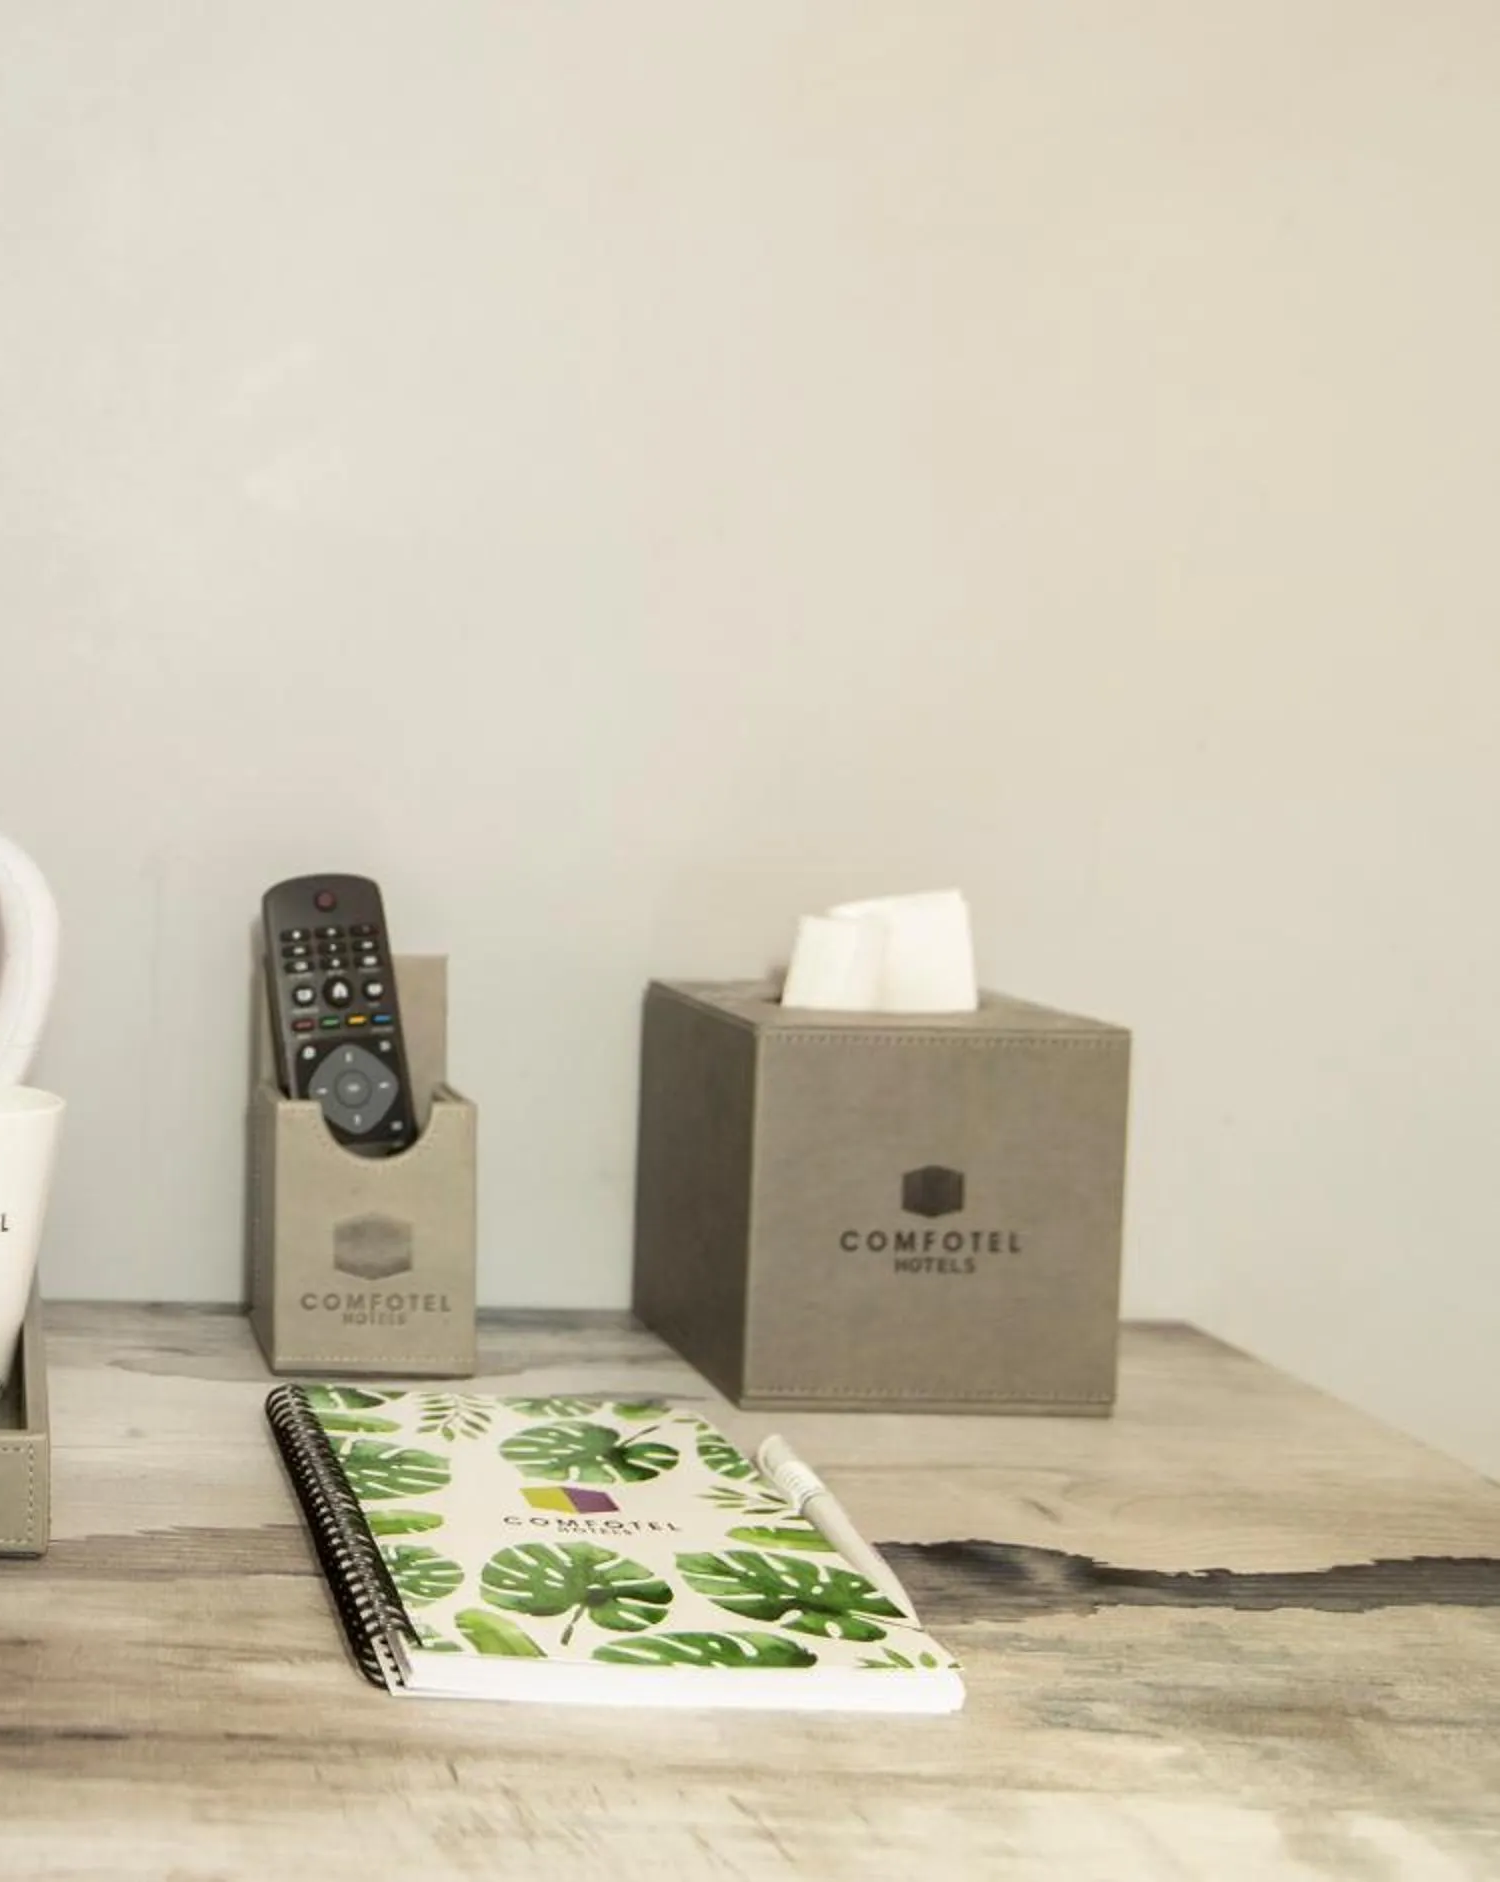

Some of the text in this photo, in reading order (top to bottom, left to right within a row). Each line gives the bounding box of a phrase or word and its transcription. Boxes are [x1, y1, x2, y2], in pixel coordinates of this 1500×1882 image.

[840, 1230, 1021, 1253] COMFOTEL
[894, 1257, 976, 1274] HOTELS
[300, 1292, 452, 1312] COMFOTEL
[342, 1312, 407, 1326] HOTELS
[503, 1515, 681, 1533] COMFOTEL
[557, 1526, 633, 1536] HOTELS
